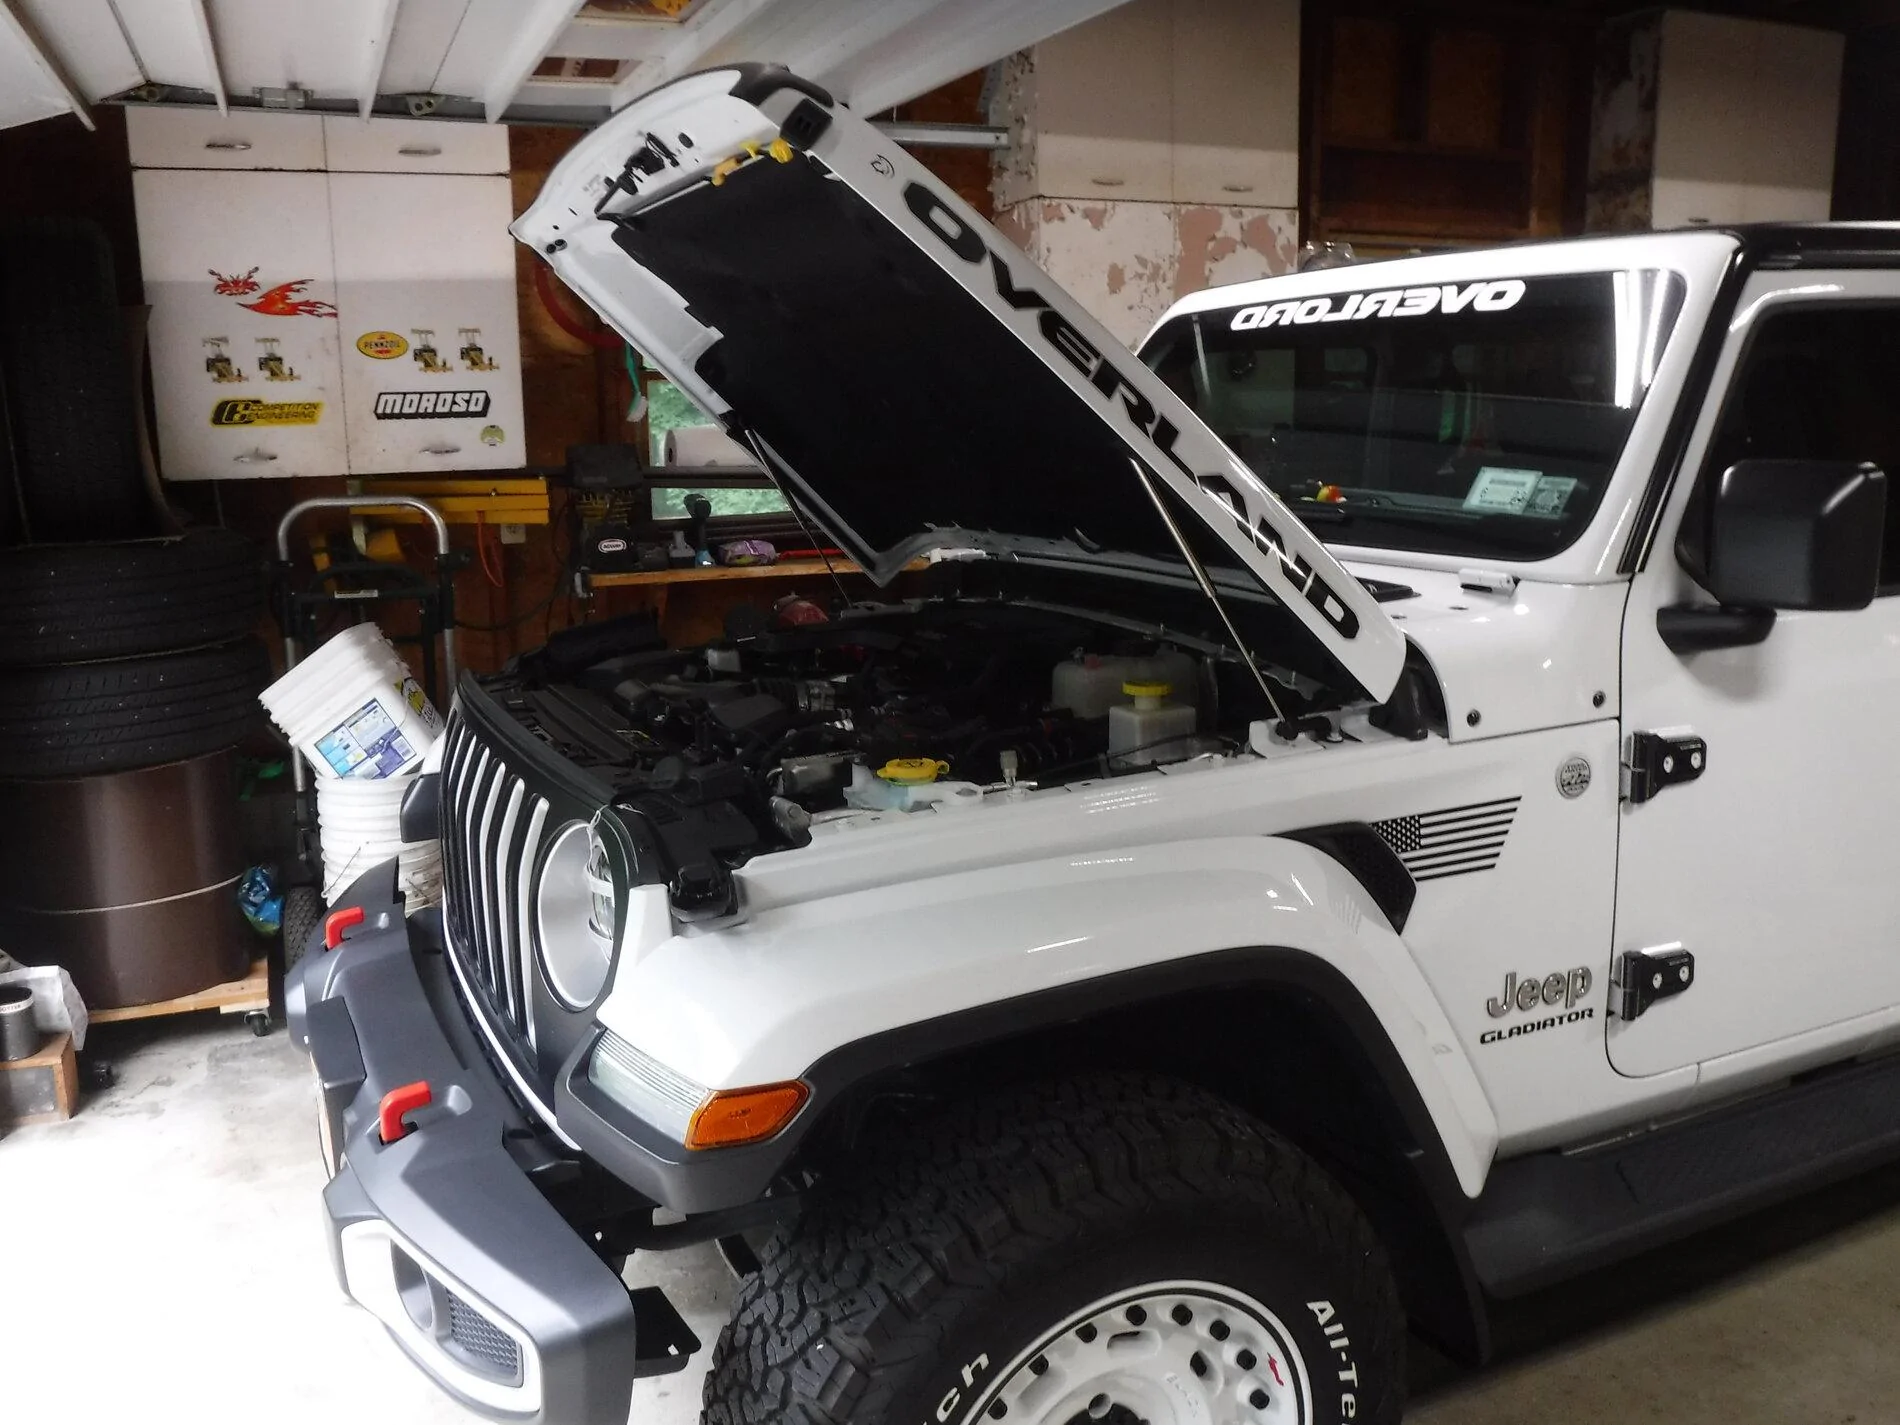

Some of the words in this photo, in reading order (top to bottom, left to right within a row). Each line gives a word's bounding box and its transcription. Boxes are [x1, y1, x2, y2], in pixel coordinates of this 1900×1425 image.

[364, 340, 400, 349] PENNZOIL
[374, 391, 490, 419] MOROSO
[903, 182, 1360, 639] OVERLAND
[1487, 966, 1592, 1018] Jeep
[1480, 1008, 1594, 1044] GLADIATOR
[1306, 1300, 1358, 1425] All-Te
[923, 1353, 989, 1425] ch
